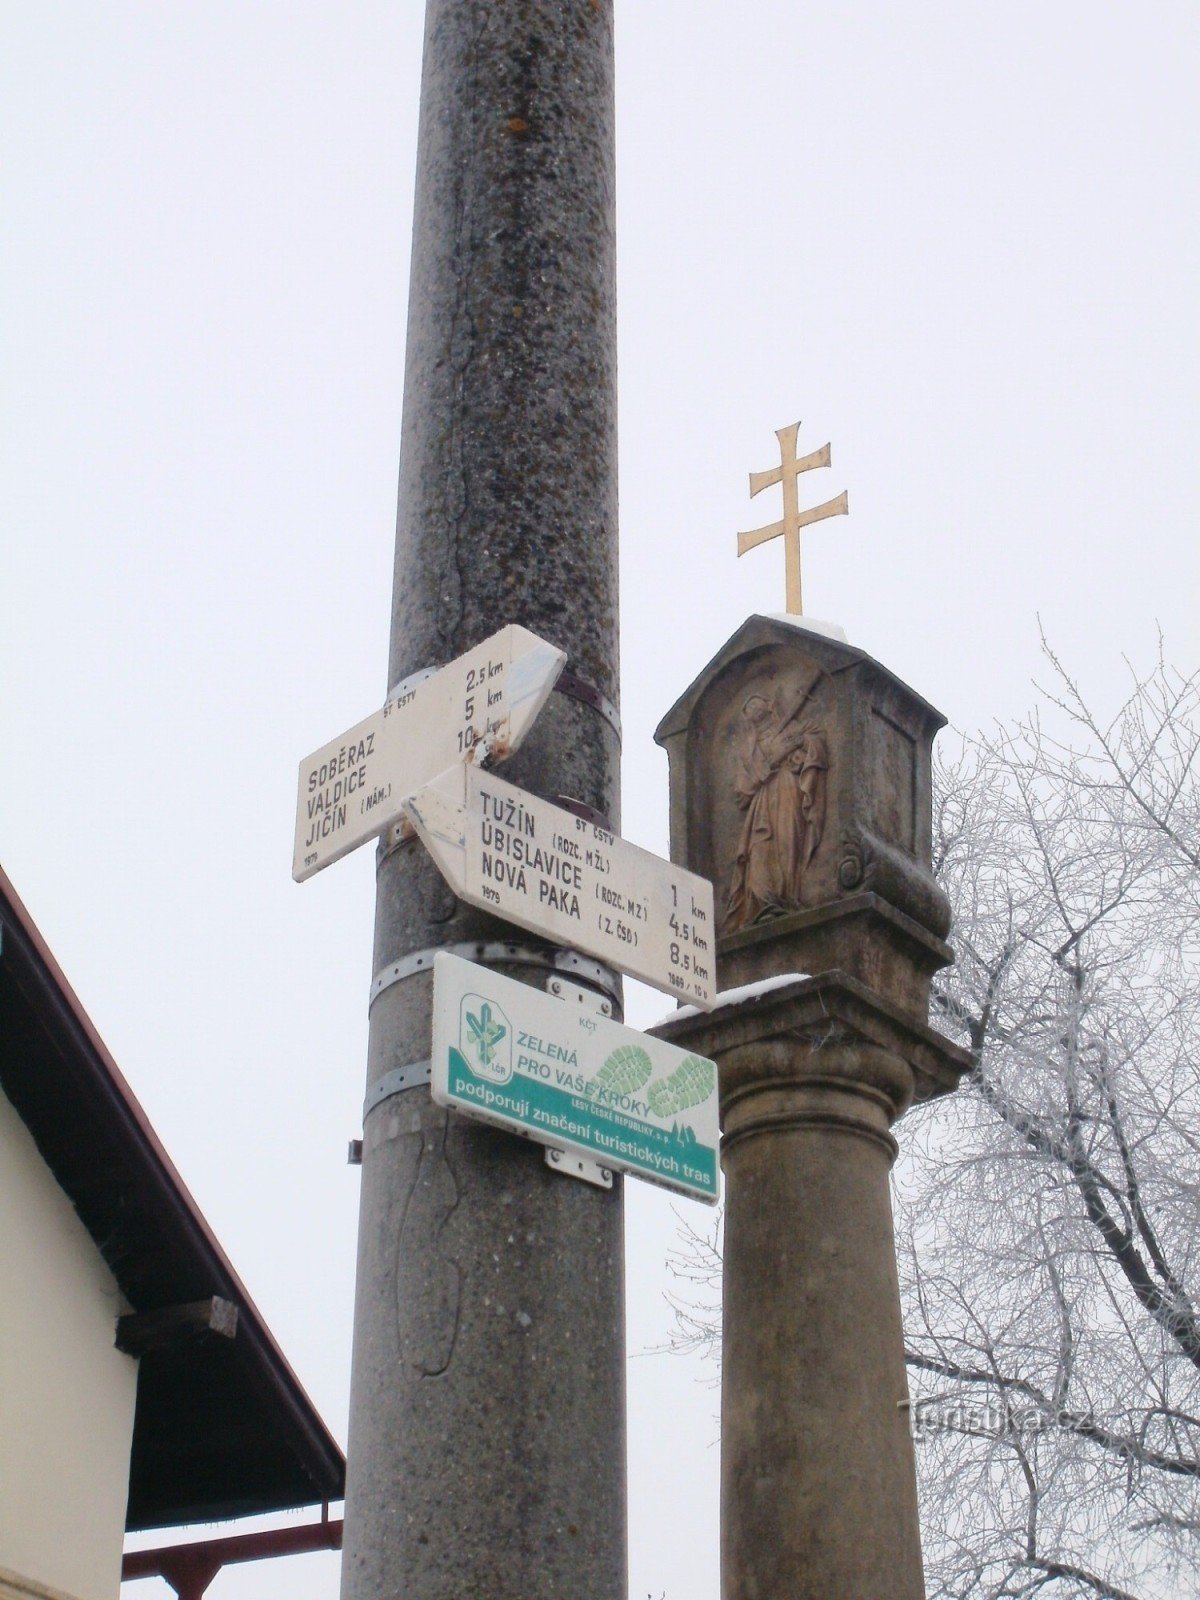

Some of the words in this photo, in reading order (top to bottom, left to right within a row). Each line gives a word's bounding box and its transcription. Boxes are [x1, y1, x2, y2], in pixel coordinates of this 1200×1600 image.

[465, 696, 475, 721] 5
[487, 688, 502, 707] km
[466, 667, 486, 693] 2.5
[488, 660, 503, 679] km
[308, 732, 376, 793] SOBĚRAZ
[457, 725, 475, 753] 10
[305, 805, 347, 847] JIČÍN
[360, 782, 392, 815] (NÁM.)
[307, 765, 367, 819] VALDICE
[480, 790, 536, 838] TUŽÍN
[671, 884, 678, 907] 1
[691, 896, 707, 921] km
[576, 818, 587, 832] ST
[481, 820, 583, 890] ÚBISLAVICE
[669, 912, 690, 941] 4.5
[692, 923, 708, 951] km
[481, 851, 527, 894] NOVÁ
[539, 879, 581, 920] PAKA
[670, 942, 690, 971] 8.5
[693, 953, 709, 981] km
[516, 1030, 579, 1067] ZELENÁ
[517, 1057, 551, 1080] PRO
[554, 1069, 595, 1095] VAŠE
[595, 1084, 652, 1119] KROKY
[455, 1077, 530, 1117] podporují
[533, 1107, 591, 1139] značení
[593, 1128, 679, 1174] turistických
[682, 1162, 711, 1186] tras
